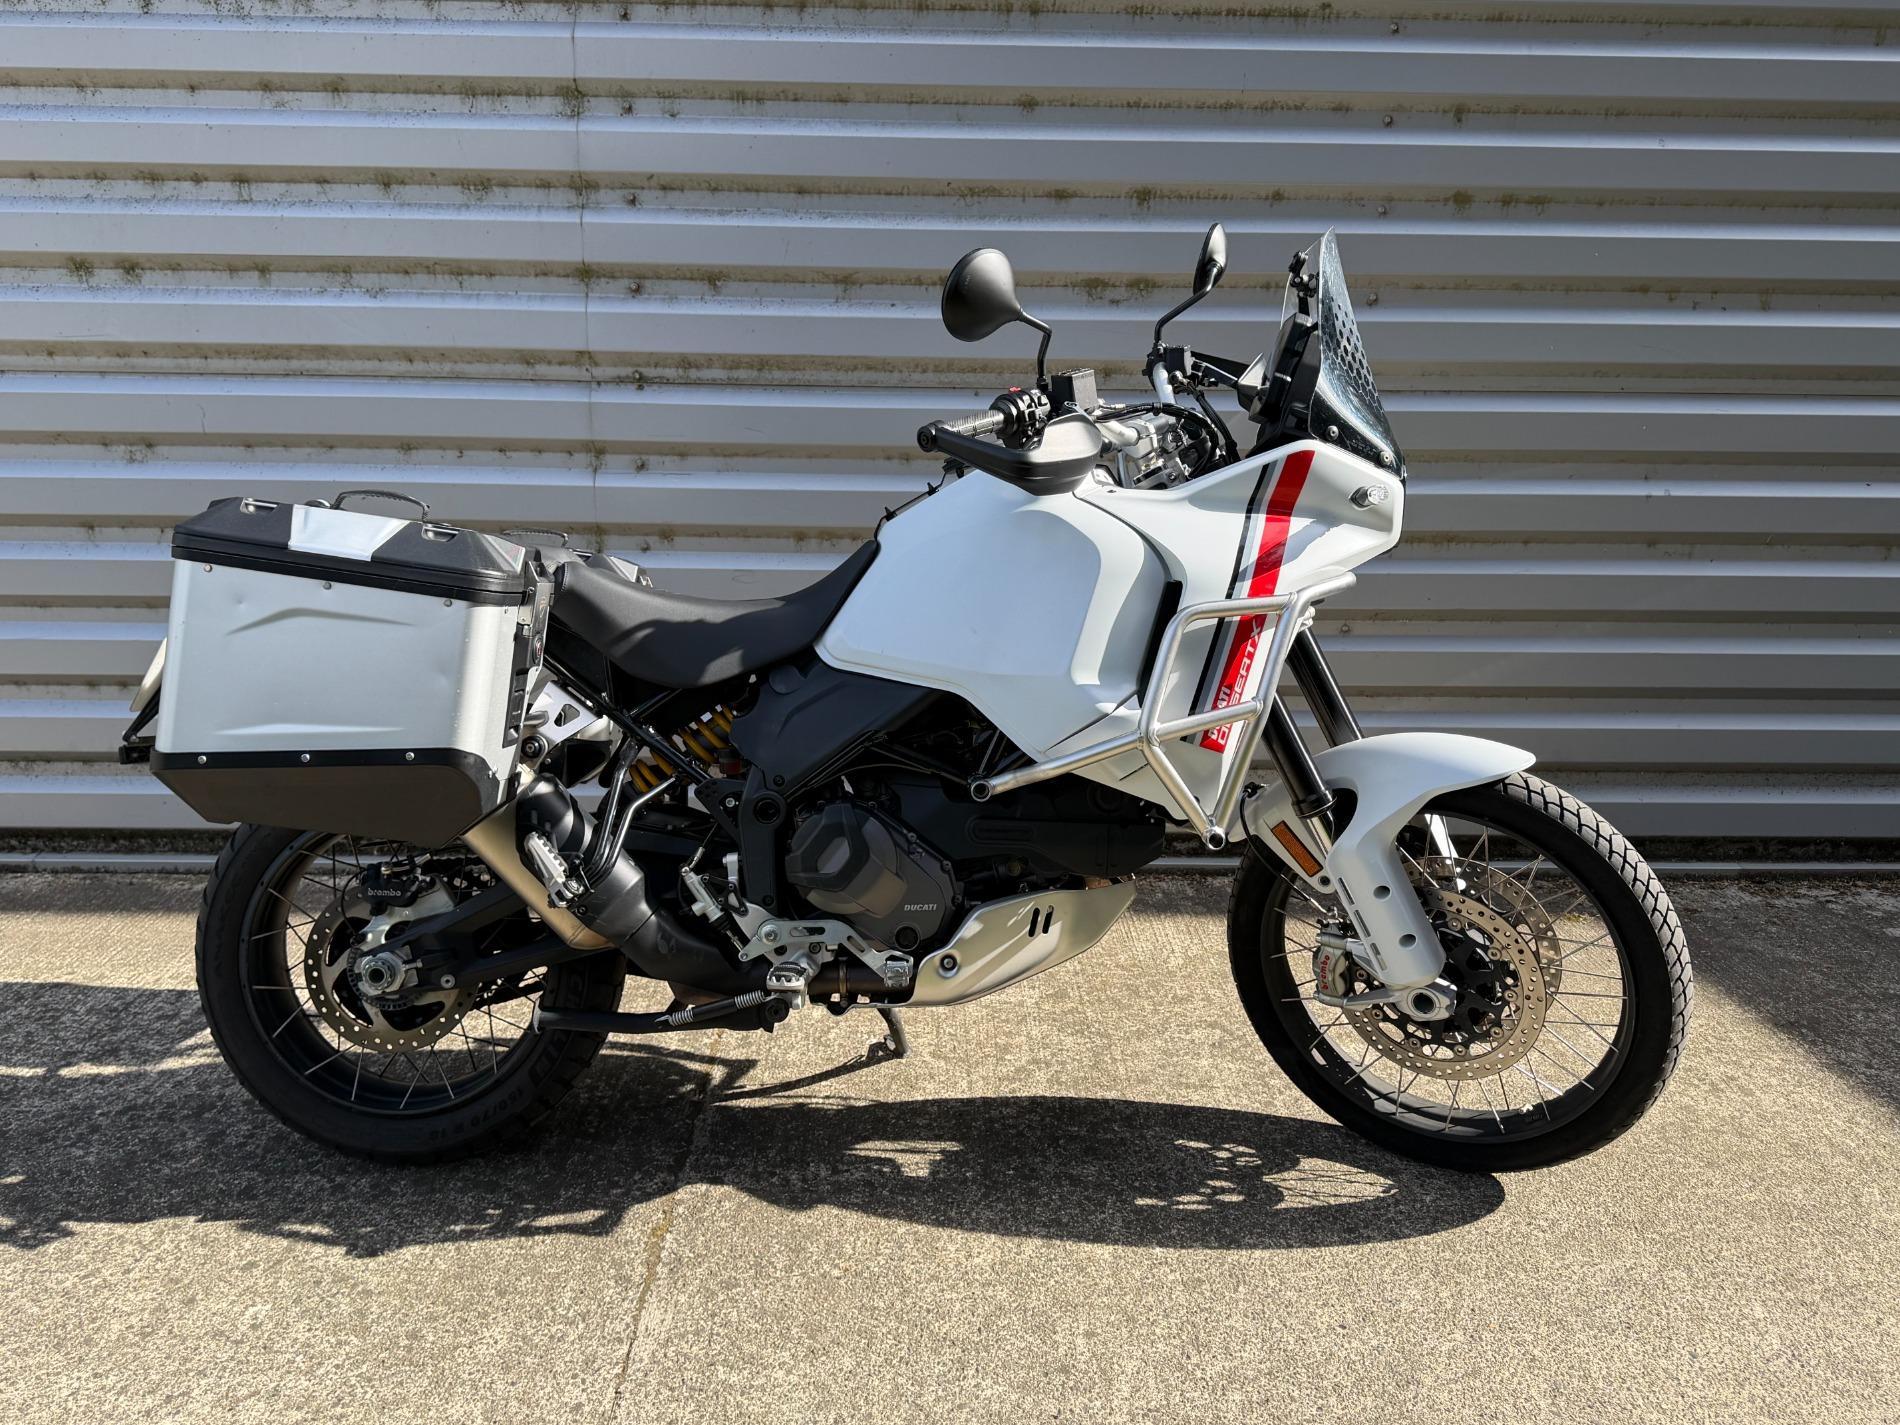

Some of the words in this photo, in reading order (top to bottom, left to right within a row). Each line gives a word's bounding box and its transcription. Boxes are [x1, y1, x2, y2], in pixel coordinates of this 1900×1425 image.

[1218, 618, 1260, 745] DSERTX
[367, 887, 402, 897] brembo
[904, 903, 937, 911] DUCATI
[1320, 954, 1330, 991] brembo
